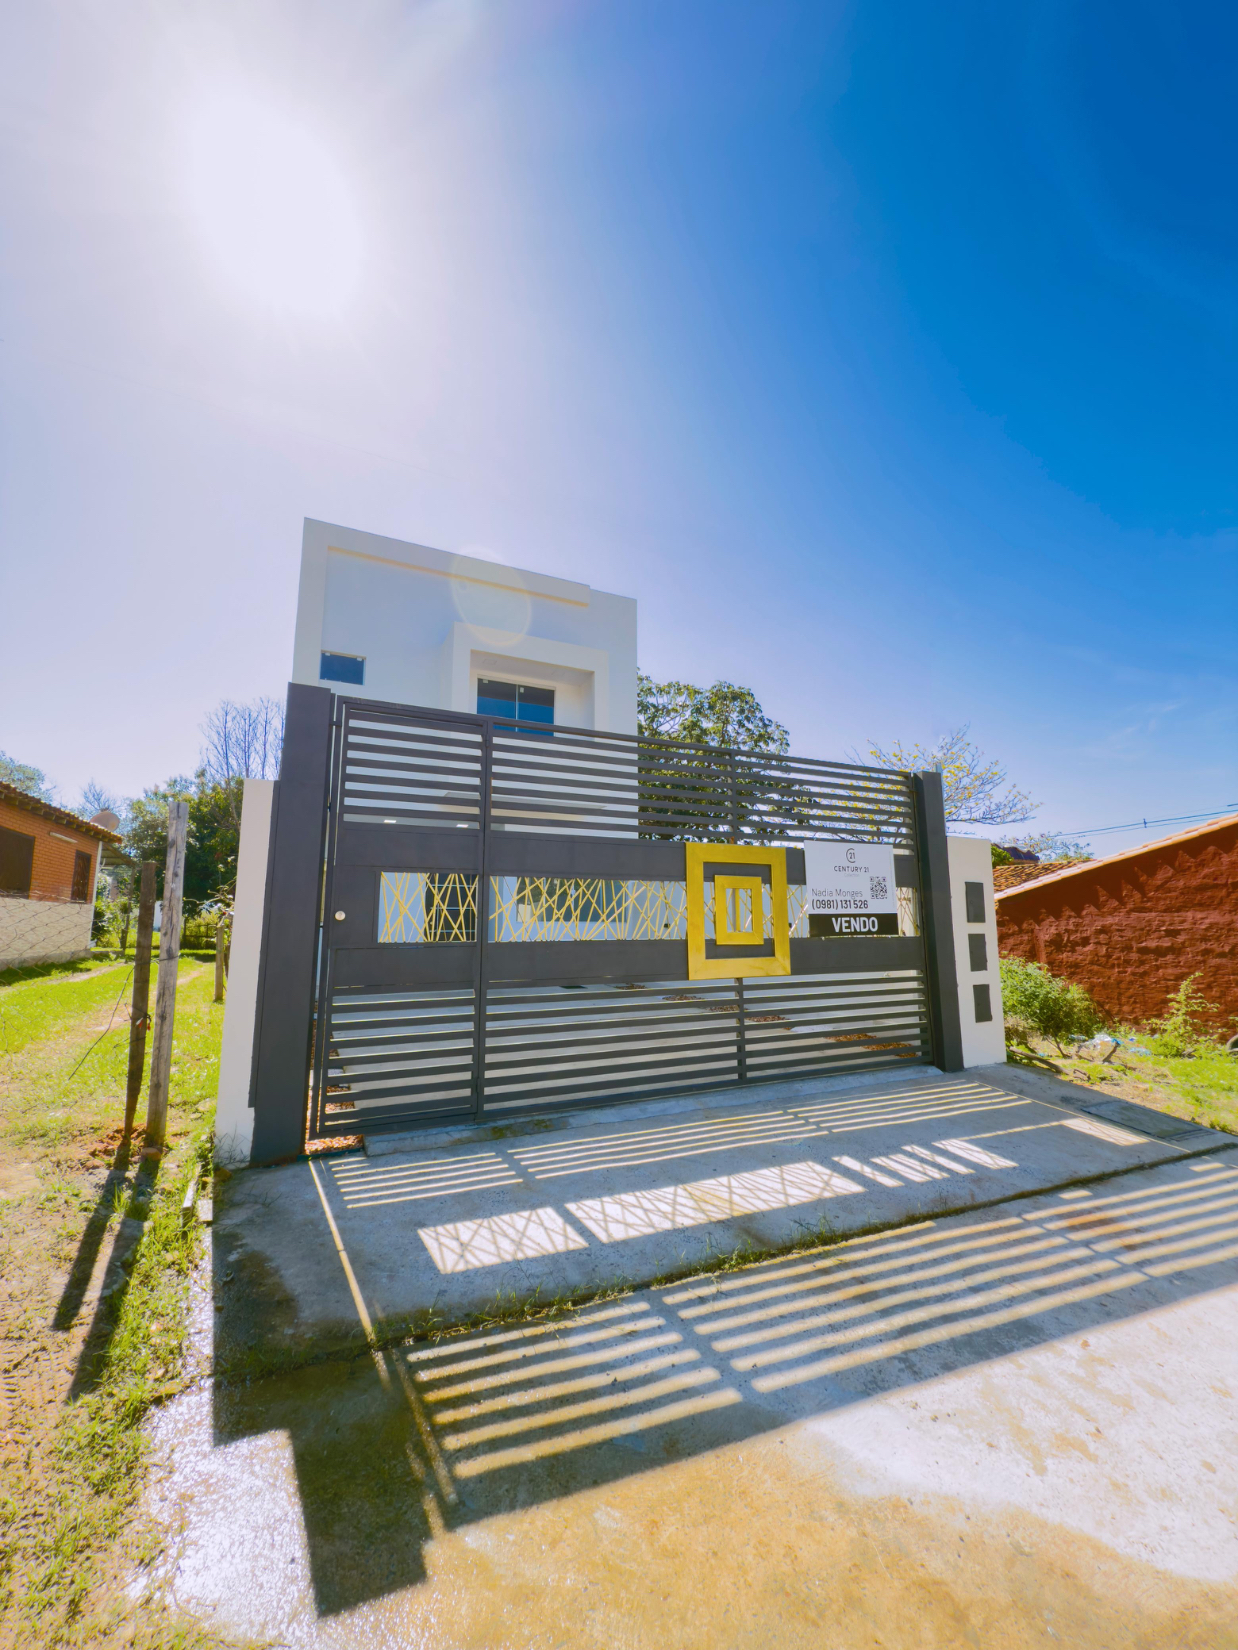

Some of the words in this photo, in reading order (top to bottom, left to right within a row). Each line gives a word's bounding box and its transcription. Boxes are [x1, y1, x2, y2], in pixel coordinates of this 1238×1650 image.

[812, 888, 834, 897] Nadia
[836, 889, 863, 900] Monges
[812, 900, 839, 910] (0981)
[840, 900, 852, 909] 131
[854, 900, 869, 910] 526
[832, 917, 879, 932] VENDO
